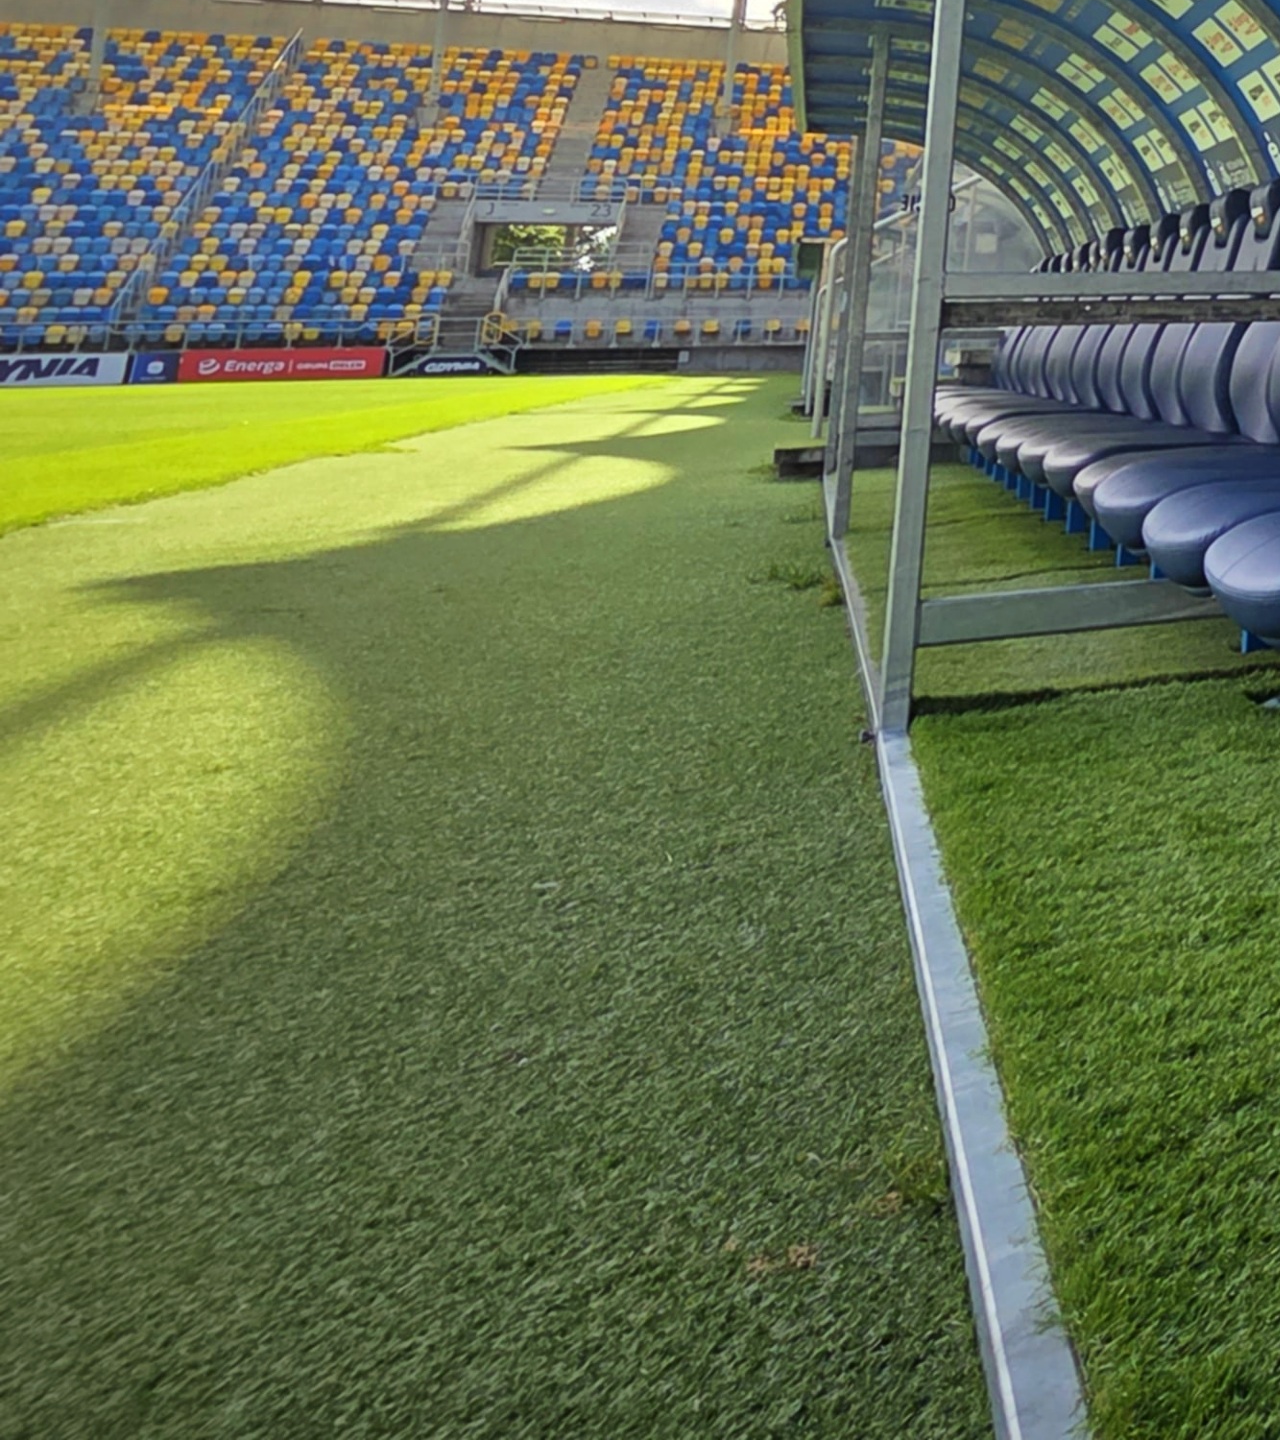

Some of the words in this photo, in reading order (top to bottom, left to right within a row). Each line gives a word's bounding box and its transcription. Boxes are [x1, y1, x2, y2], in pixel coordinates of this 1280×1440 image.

[590, 204, 612, 217] 23
[224, 359, 285, 374] Energa
[424, 362, 480, 373] GDYNIA
